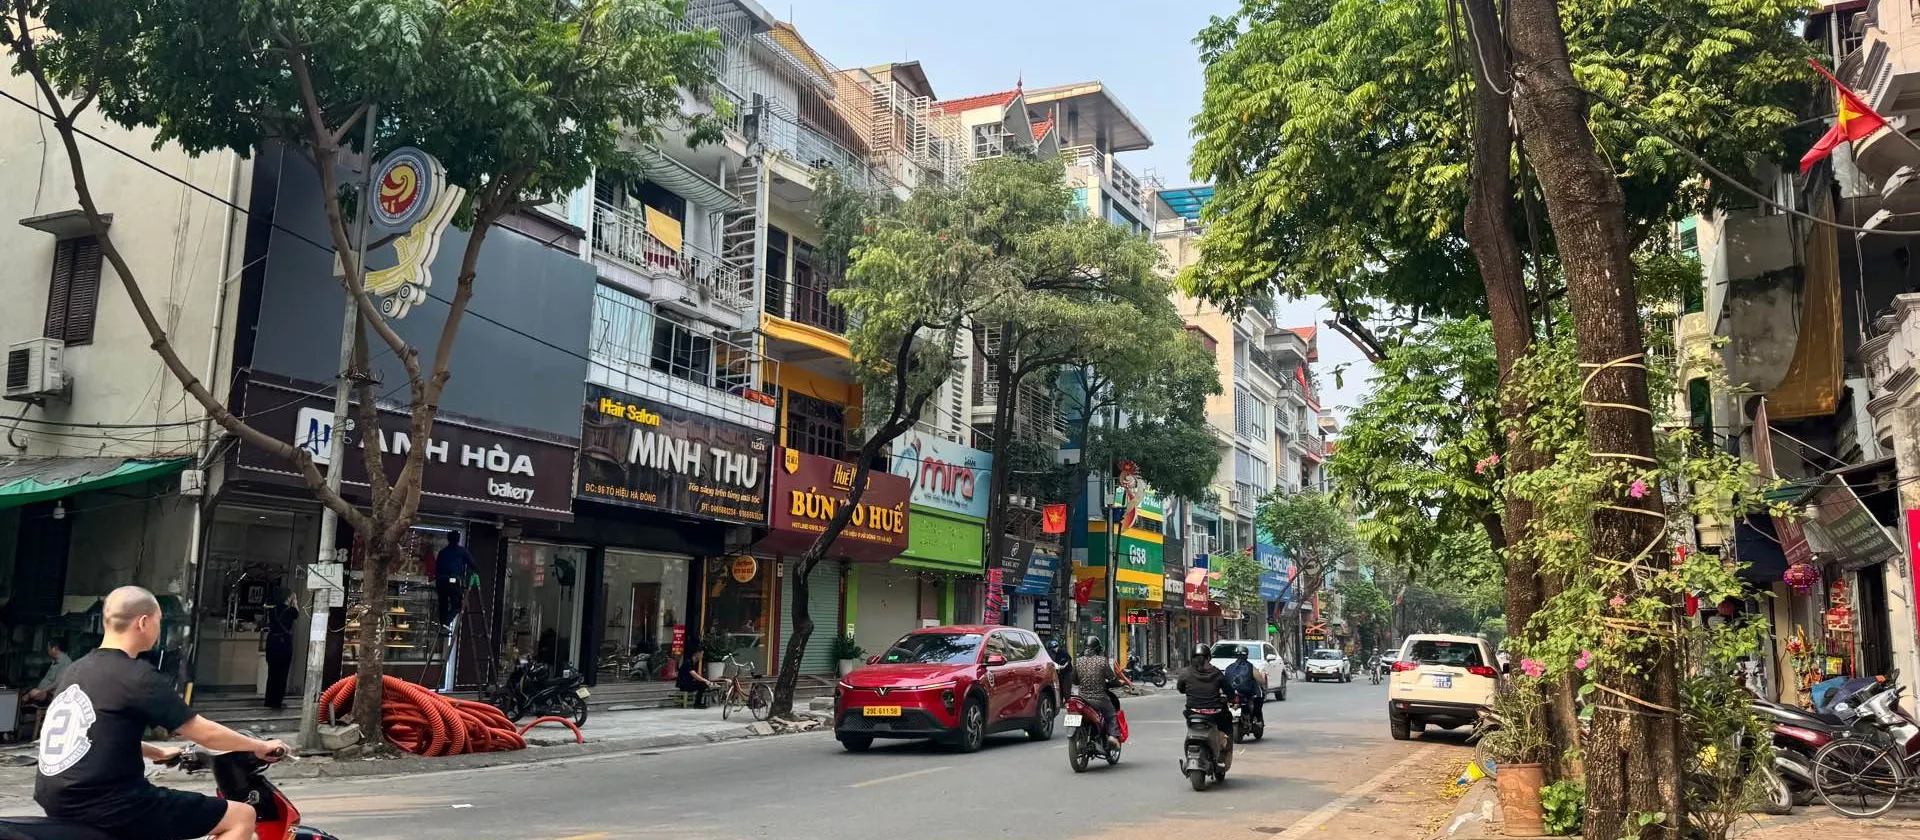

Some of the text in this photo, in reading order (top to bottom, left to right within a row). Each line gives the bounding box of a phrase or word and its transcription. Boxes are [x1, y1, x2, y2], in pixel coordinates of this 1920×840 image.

[600, 397, 661, 427] Hair Salon
[460, 443, 536, 477] HÒA
[628, 427, 758, 489] MINH THU
[920, 455, 975, 500] mira
[487, 477, 536, 504] bakery
[791, 486, 836, 521] BÚN
[868, 502, 905, 534] HUẾ
[44, 708, 73, 755] 2
